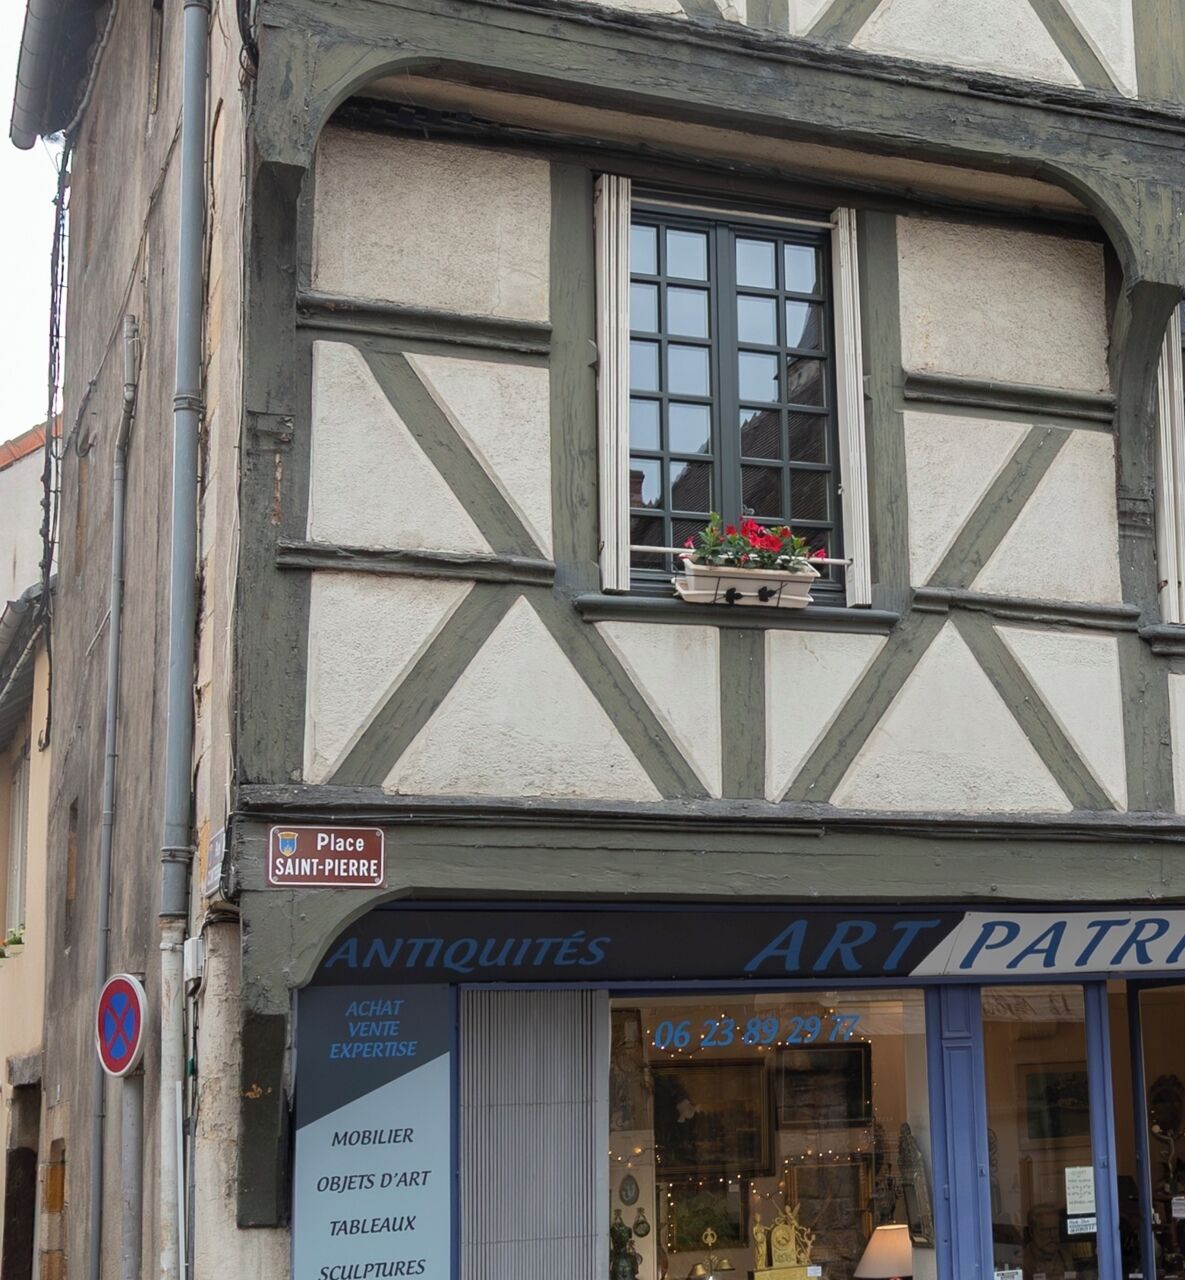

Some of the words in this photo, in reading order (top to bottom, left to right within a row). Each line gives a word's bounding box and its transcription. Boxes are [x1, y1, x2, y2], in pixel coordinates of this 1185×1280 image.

[317, 833, 364, 852] Place
[275, 858, 378, 877] SAINT-PIERRE
[325, 930, 611, 972] ANTIQUITÉS
[744, 919, 941, 971] ART
[345, 1000, 404, 1016] ACHAT
[349, 1021, 400, 1038] VENTE
[655, 1020, 691, 1048] 06
[700, 1018, 736, 1048] 23
[744, 1017, 779, 1045] 89
[786, 1016, 821, 1043] 29
[828, 1014, 861, 1042] 77
[329, 1041, 418, 1059] EXPERTISE
[331, 1128, 414, 1147] MOBILIER
[316, 1173, 375, 1194] OBJETS
[380, 1170, 431, 1189] D’ART
[330, 1215, 416, 1236] TABLEAUX
